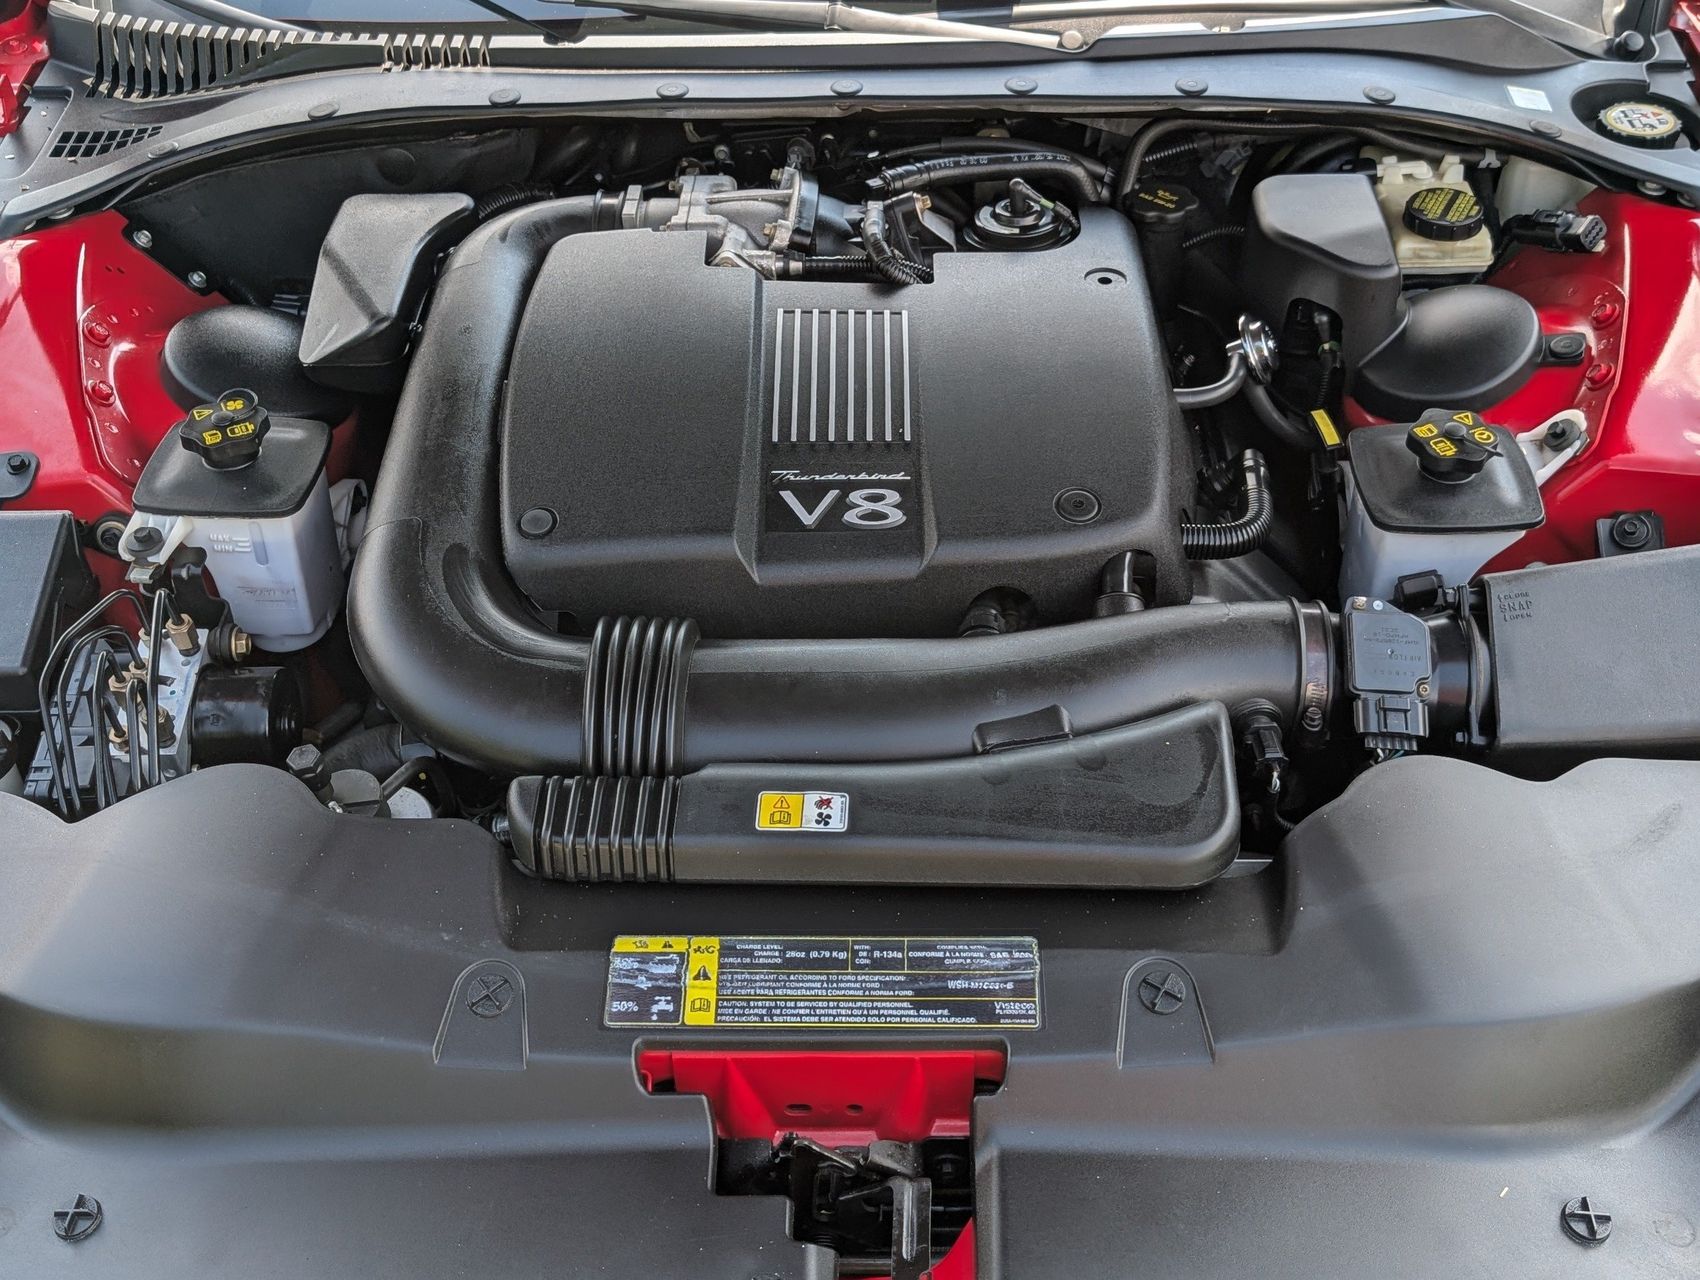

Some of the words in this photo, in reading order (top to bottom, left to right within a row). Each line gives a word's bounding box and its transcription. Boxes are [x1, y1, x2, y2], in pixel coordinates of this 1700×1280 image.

[770, 470, 911, 483] Thunderbird
[779, 488, 907, 529] V8
[209, 533, 231, 542] MAX
[1499, 600, 1533, 613] SNAP
[809, 951, 830, 959] (0.79
[832, 951, 847, 960] Kg)
[873, 950, 903, 958] R-134a
[610, 1001, 639, 1012] 50%
